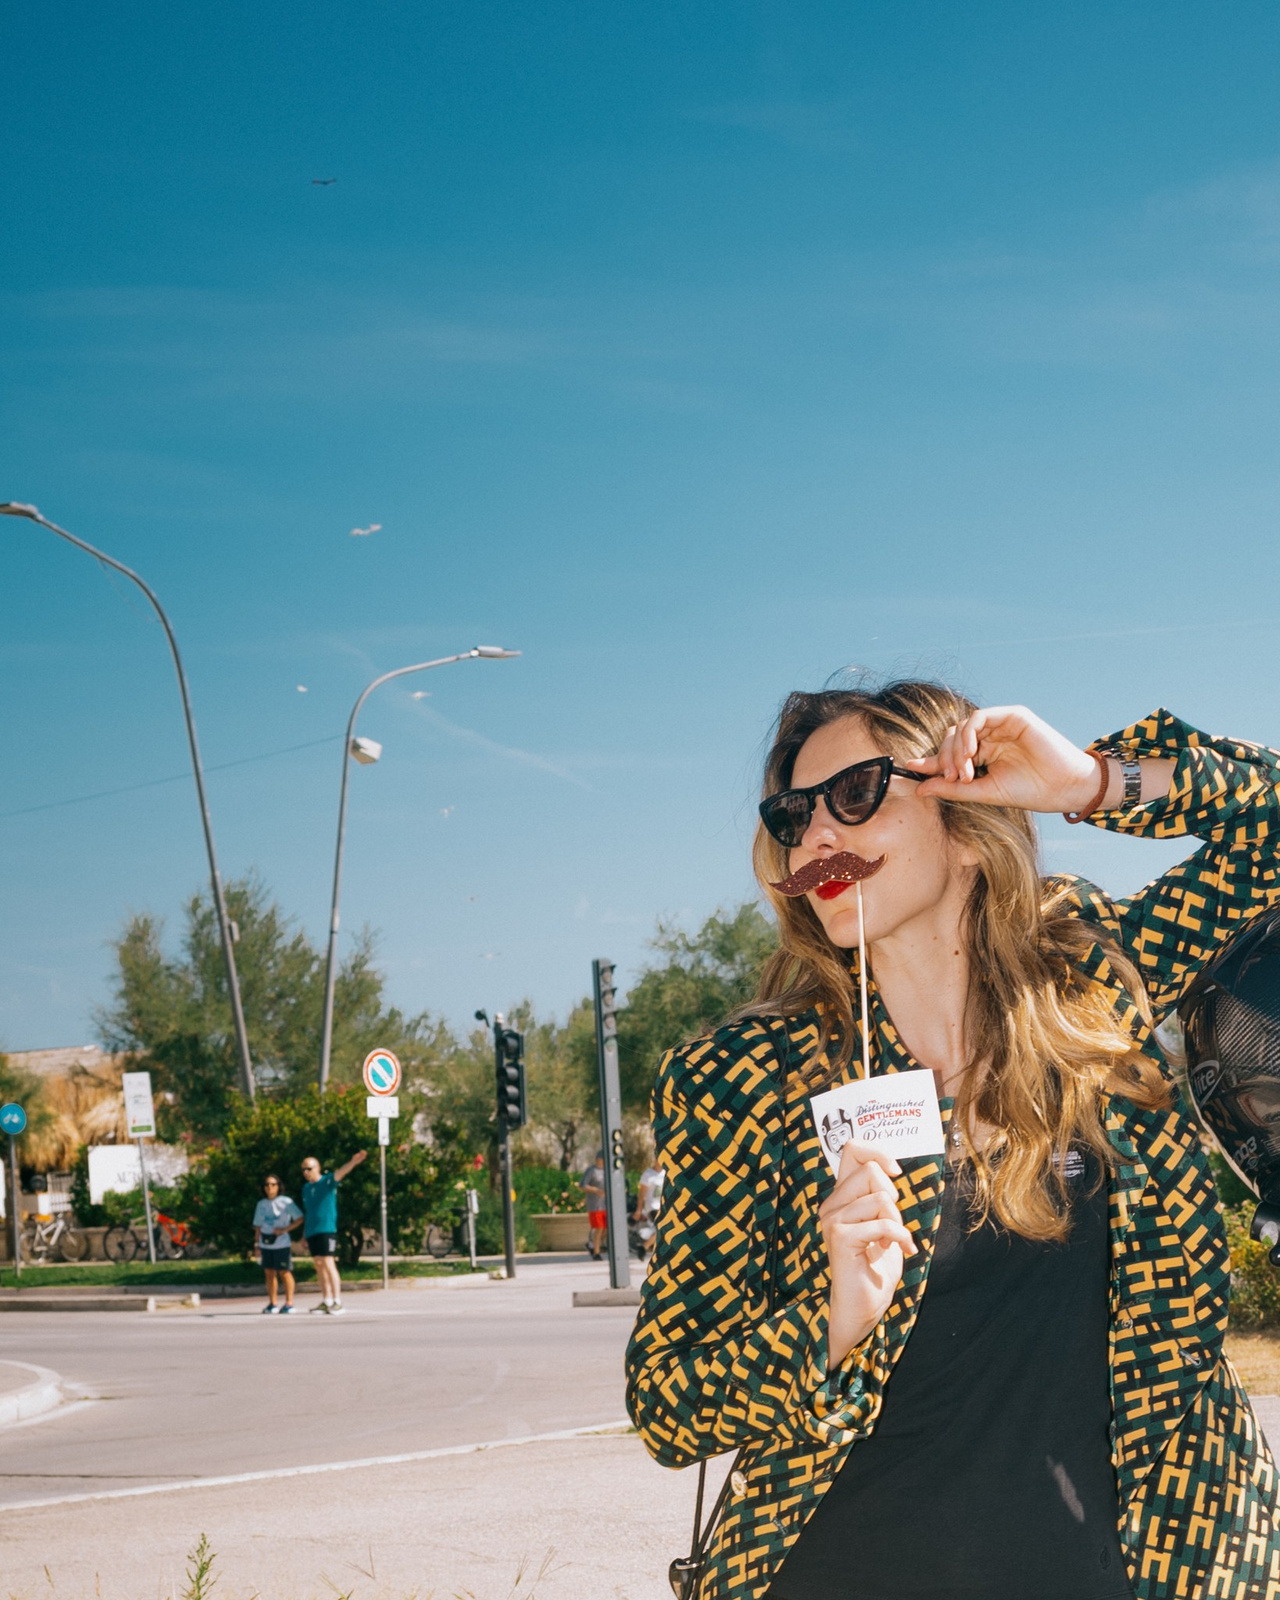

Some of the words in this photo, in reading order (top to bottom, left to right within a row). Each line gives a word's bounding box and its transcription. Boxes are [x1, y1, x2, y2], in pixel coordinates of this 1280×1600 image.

[855, 1099, 925, 1118] Distinguished
[857, 1109, 922, 1126] GENTLEMANS
[872, 1117, 904, 1129] Ride
